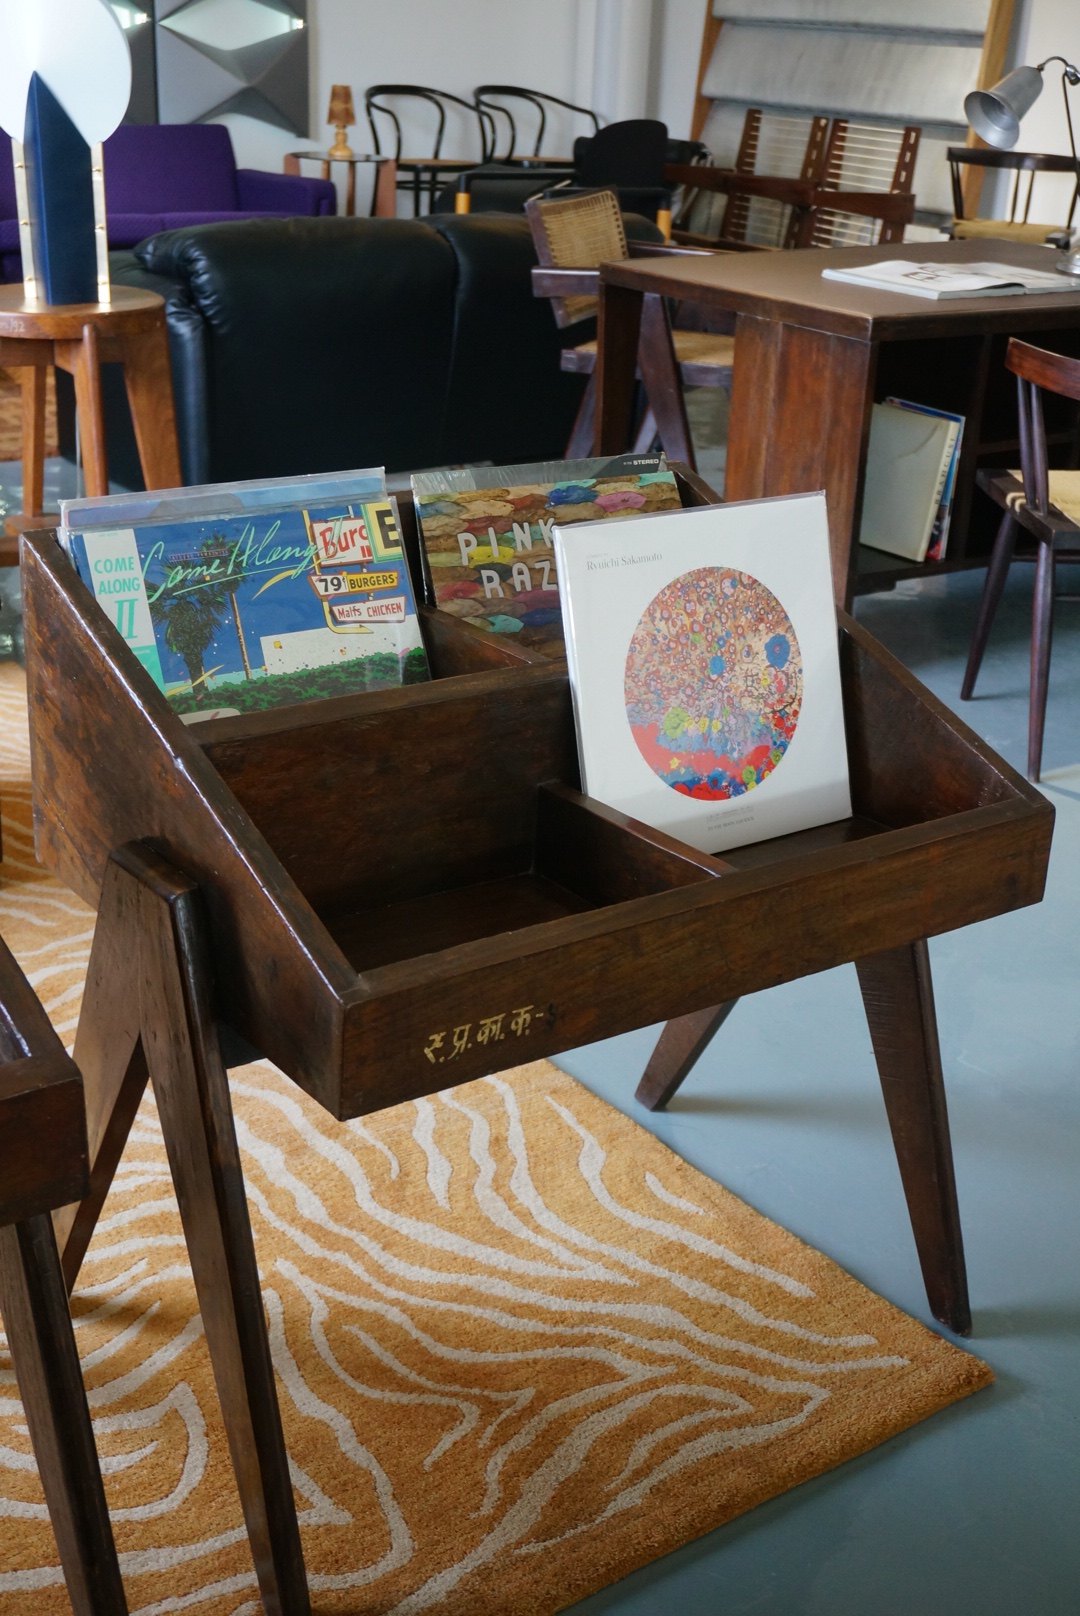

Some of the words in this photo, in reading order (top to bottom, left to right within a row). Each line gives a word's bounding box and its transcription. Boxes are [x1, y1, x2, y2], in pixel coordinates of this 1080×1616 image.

[633, 458, 660, 466] STEREO
[457, 518, 555, 566] PINK
[94, 556, 135, 574] COME
[141, 540, 225, 604] Come
[227, 519, 320, 580] Along
[586, 557, 620, 571] Ryuichi
[621, 552, 663, 566] Sakamoto
[98, 578, 141, 595] ALONG
[350, 574, 395, 589] BURGERS
[114, 598, 139, 640] II
[366, 602, 403, 618] CHICKEN
